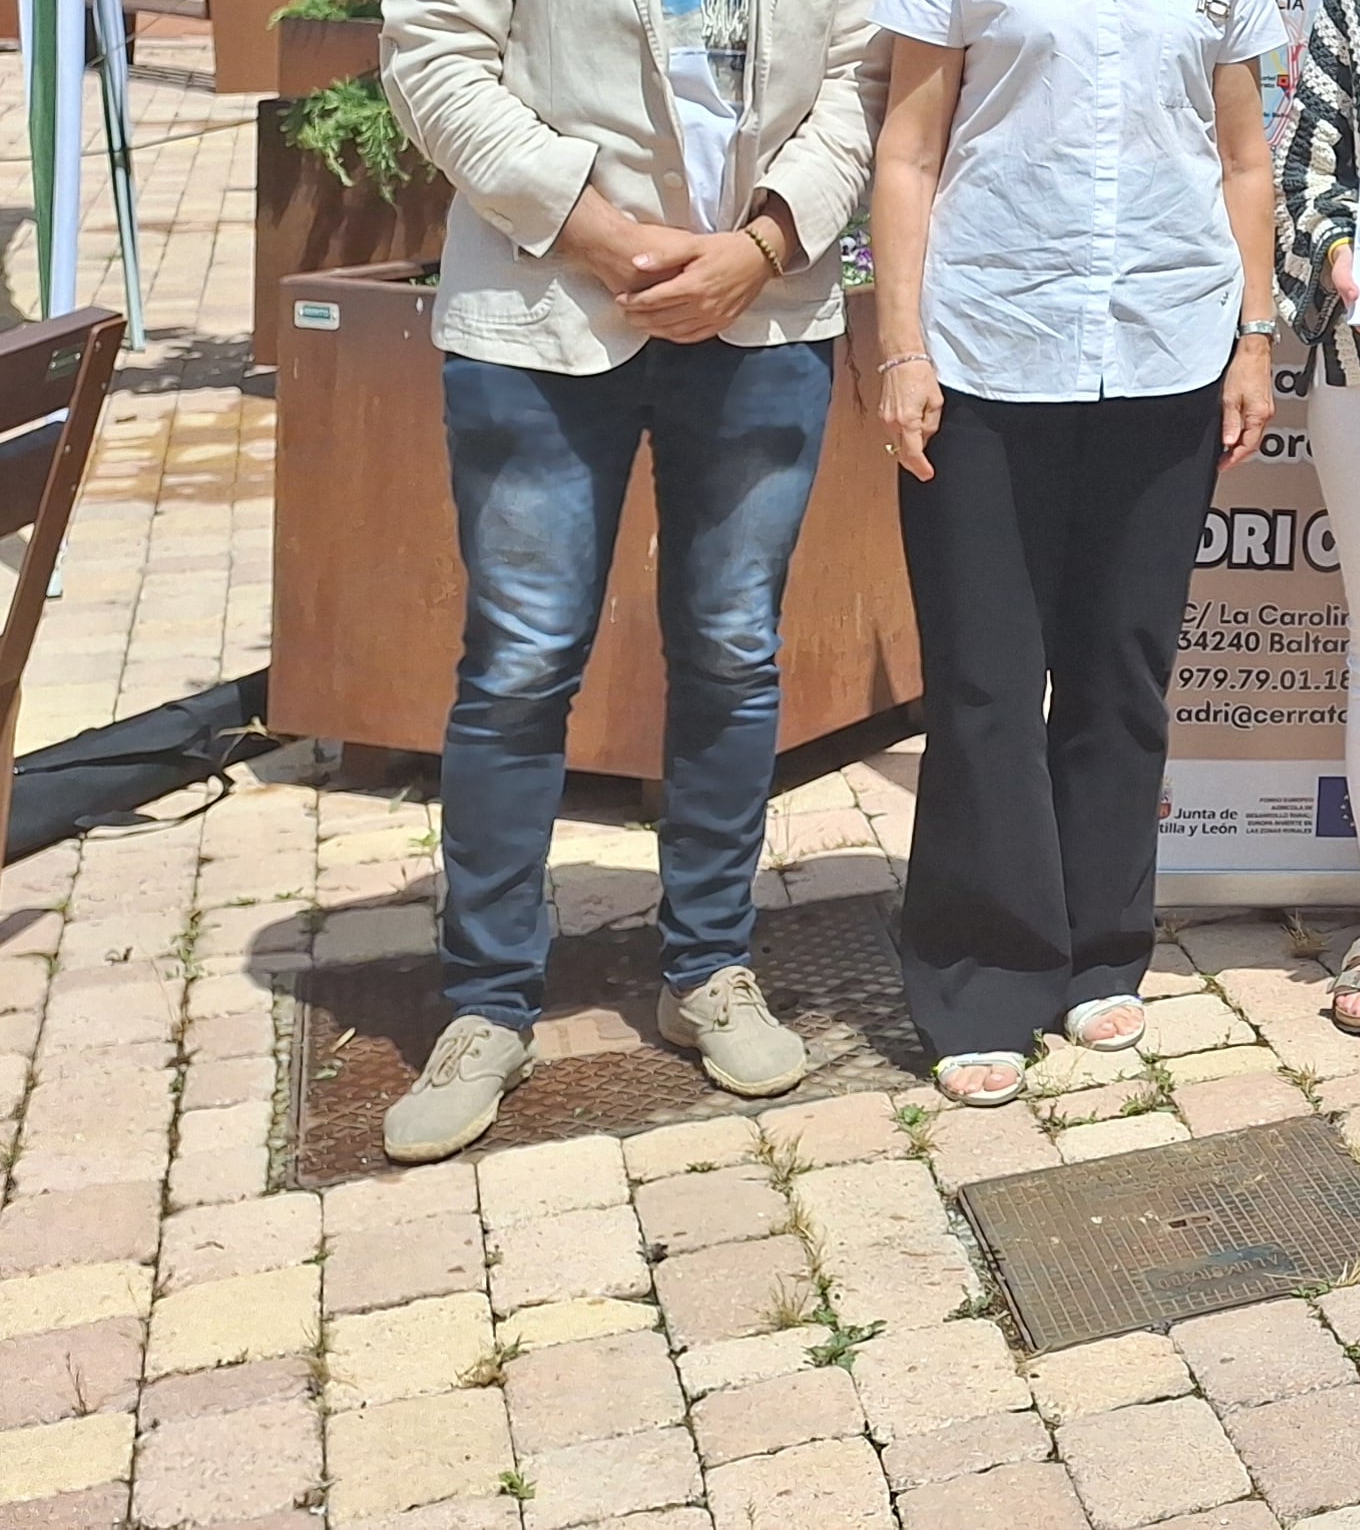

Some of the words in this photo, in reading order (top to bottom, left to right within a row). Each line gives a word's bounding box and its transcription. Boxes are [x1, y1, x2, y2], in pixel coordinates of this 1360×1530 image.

[1195, 508, 1297, 571] DRI
[1220, 603, 1249, 625] La
[1258, 603, 1349, 626] Carolin
[1177, 630, 1260, 652] 34240
[1269, 631, 1350, 654] Baltan
[1174, 808, 1215, 820] Junta
[1220, 808, 1238, 820] de
[1159, 822, 1185, 834] tilla
[1187, 825, 1199, 837] y
[1202, 822, 1238, 835] León
